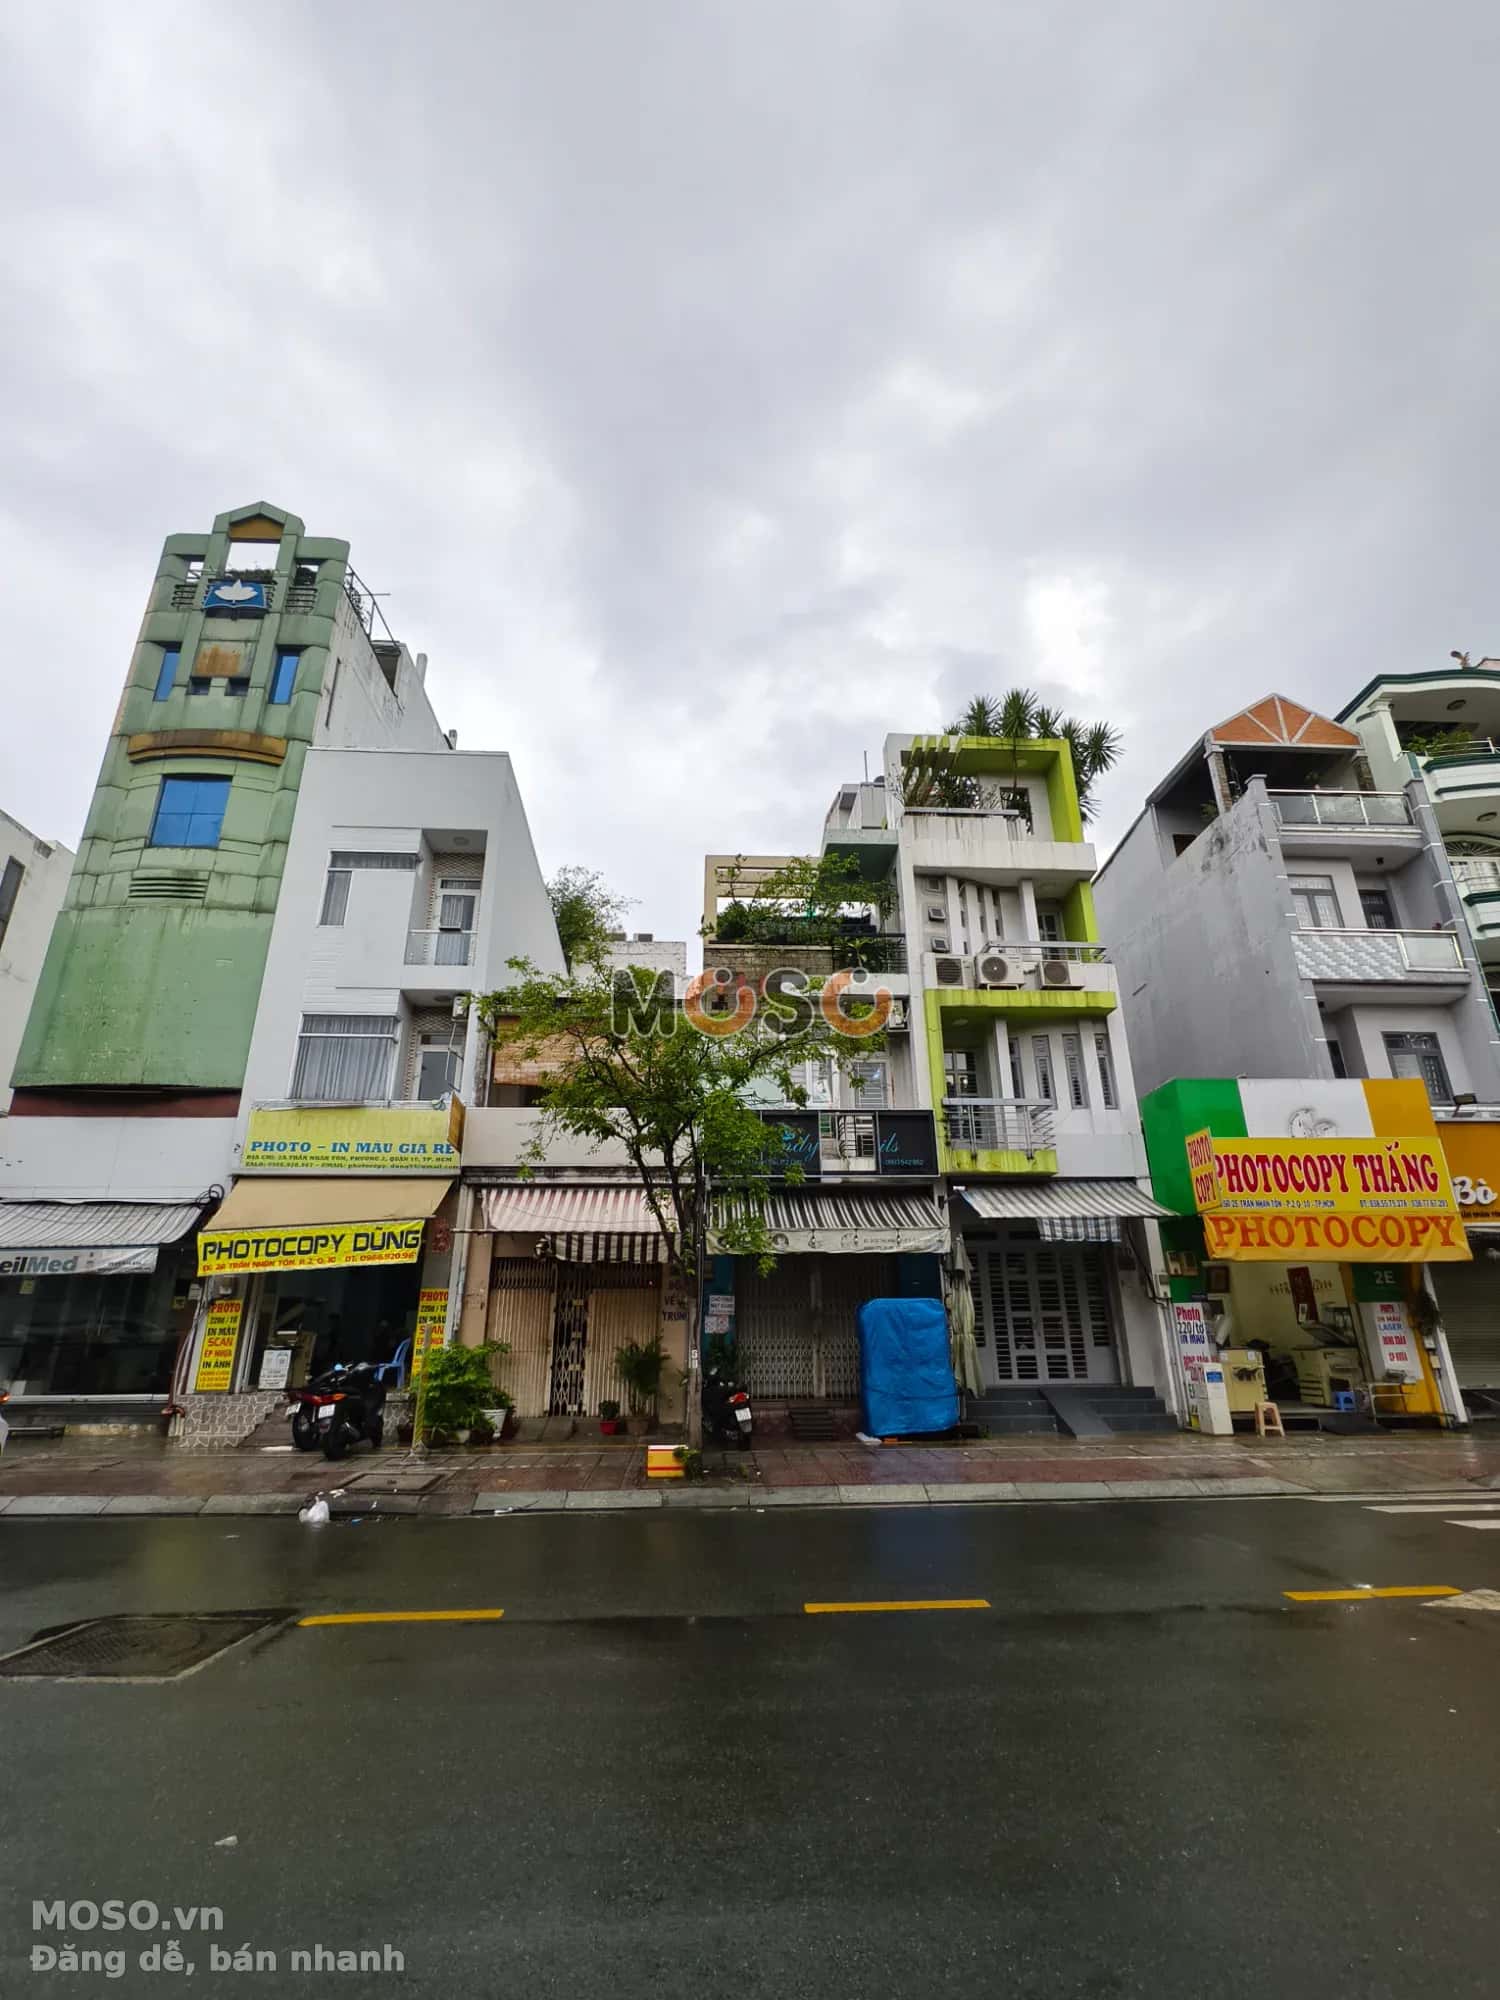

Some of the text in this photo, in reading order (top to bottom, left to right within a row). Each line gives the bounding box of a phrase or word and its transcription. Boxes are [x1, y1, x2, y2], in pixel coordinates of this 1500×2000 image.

[251, 1141, 312, 1153] PHOTO
[330, 1142, 350, 1153] IN
[1187, 1135, 1217, 1204] PHOTO COPY
[1215, 1140, 1439, 1193] PHOTOCOPY THẮNG
[1209, 1215, 1457, 1248] PHOTOCOPY
[202, 1233, 346, 1261] PHOTOCOPY
[352, 1226, 420, 1252] DŨNG
[0, 1256, 79, 1273] eilMed
[211, 1302, 241, 1313] PHOTO
[1176, 1305, 1201, 1321] Photo
[419, 1325, 445, 1335] SAN
[208, 1336, 234, 1347] SCAN
[202, 1361, 212, 1369] IN
